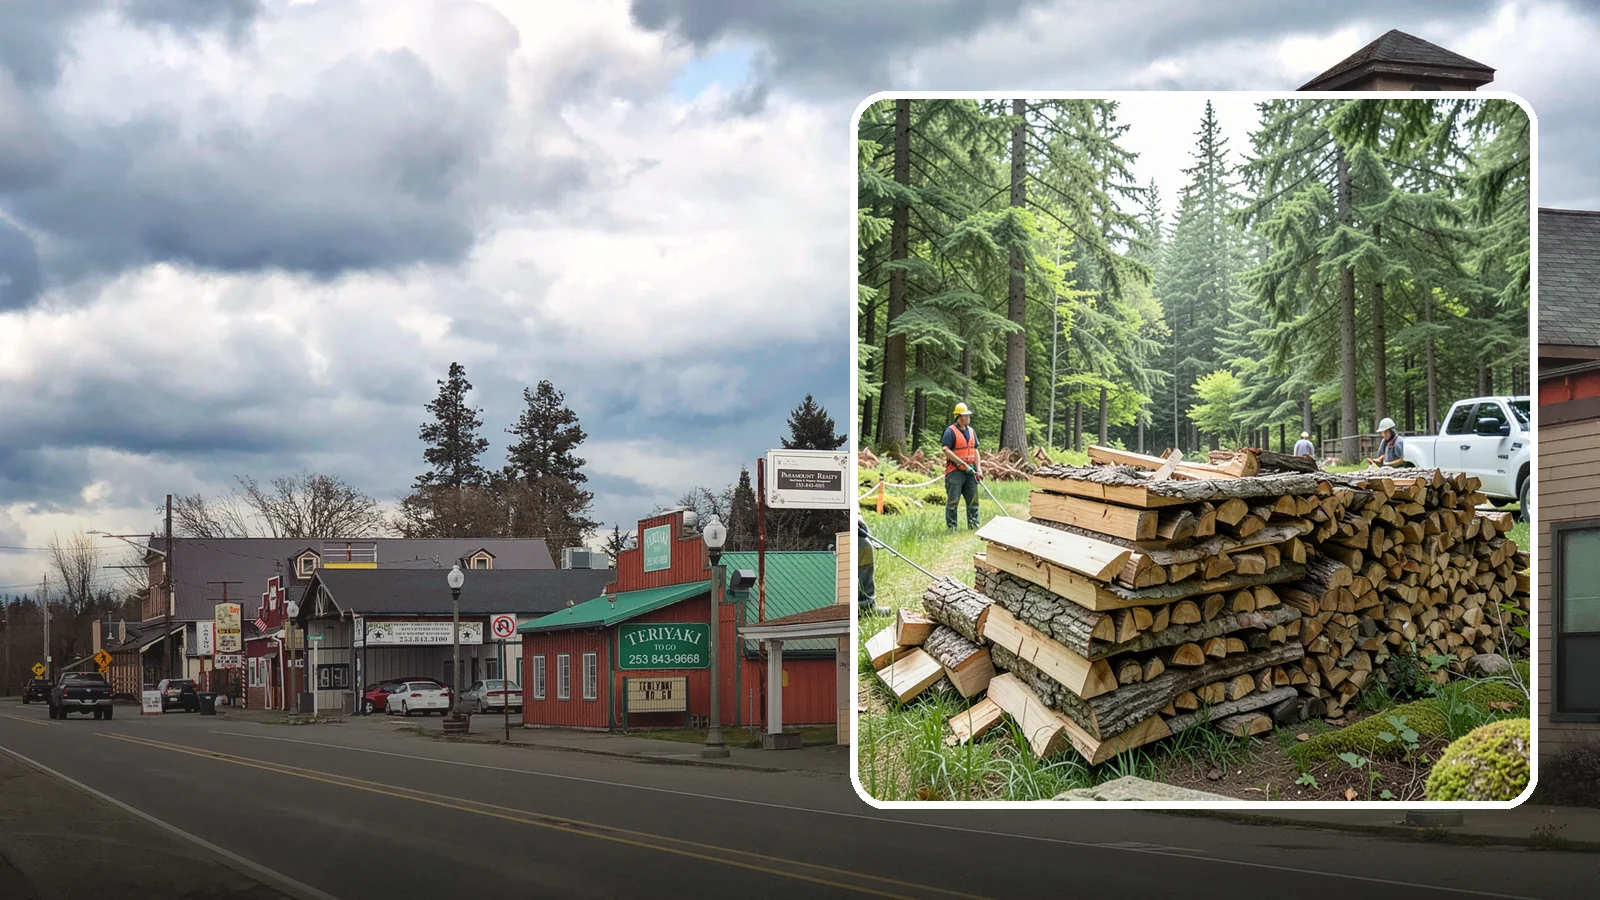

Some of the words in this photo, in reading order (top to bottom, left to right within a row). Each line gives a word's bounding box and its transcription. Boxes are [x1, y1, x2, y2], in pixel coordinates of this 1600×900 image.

[781, 471, 815, 479] PARAMOUNT
[817, 472, 839, 480] REALTY
[624, 627, 702, 646] TERIYAKI
[654, 643, 664, 651] TO
[665, 643, 677, 651] GO
[628, 654, 649, 665] 253
[651, 653, 700, 664] 843-9668
[639, 681, 673, 691] TERIYAKI
